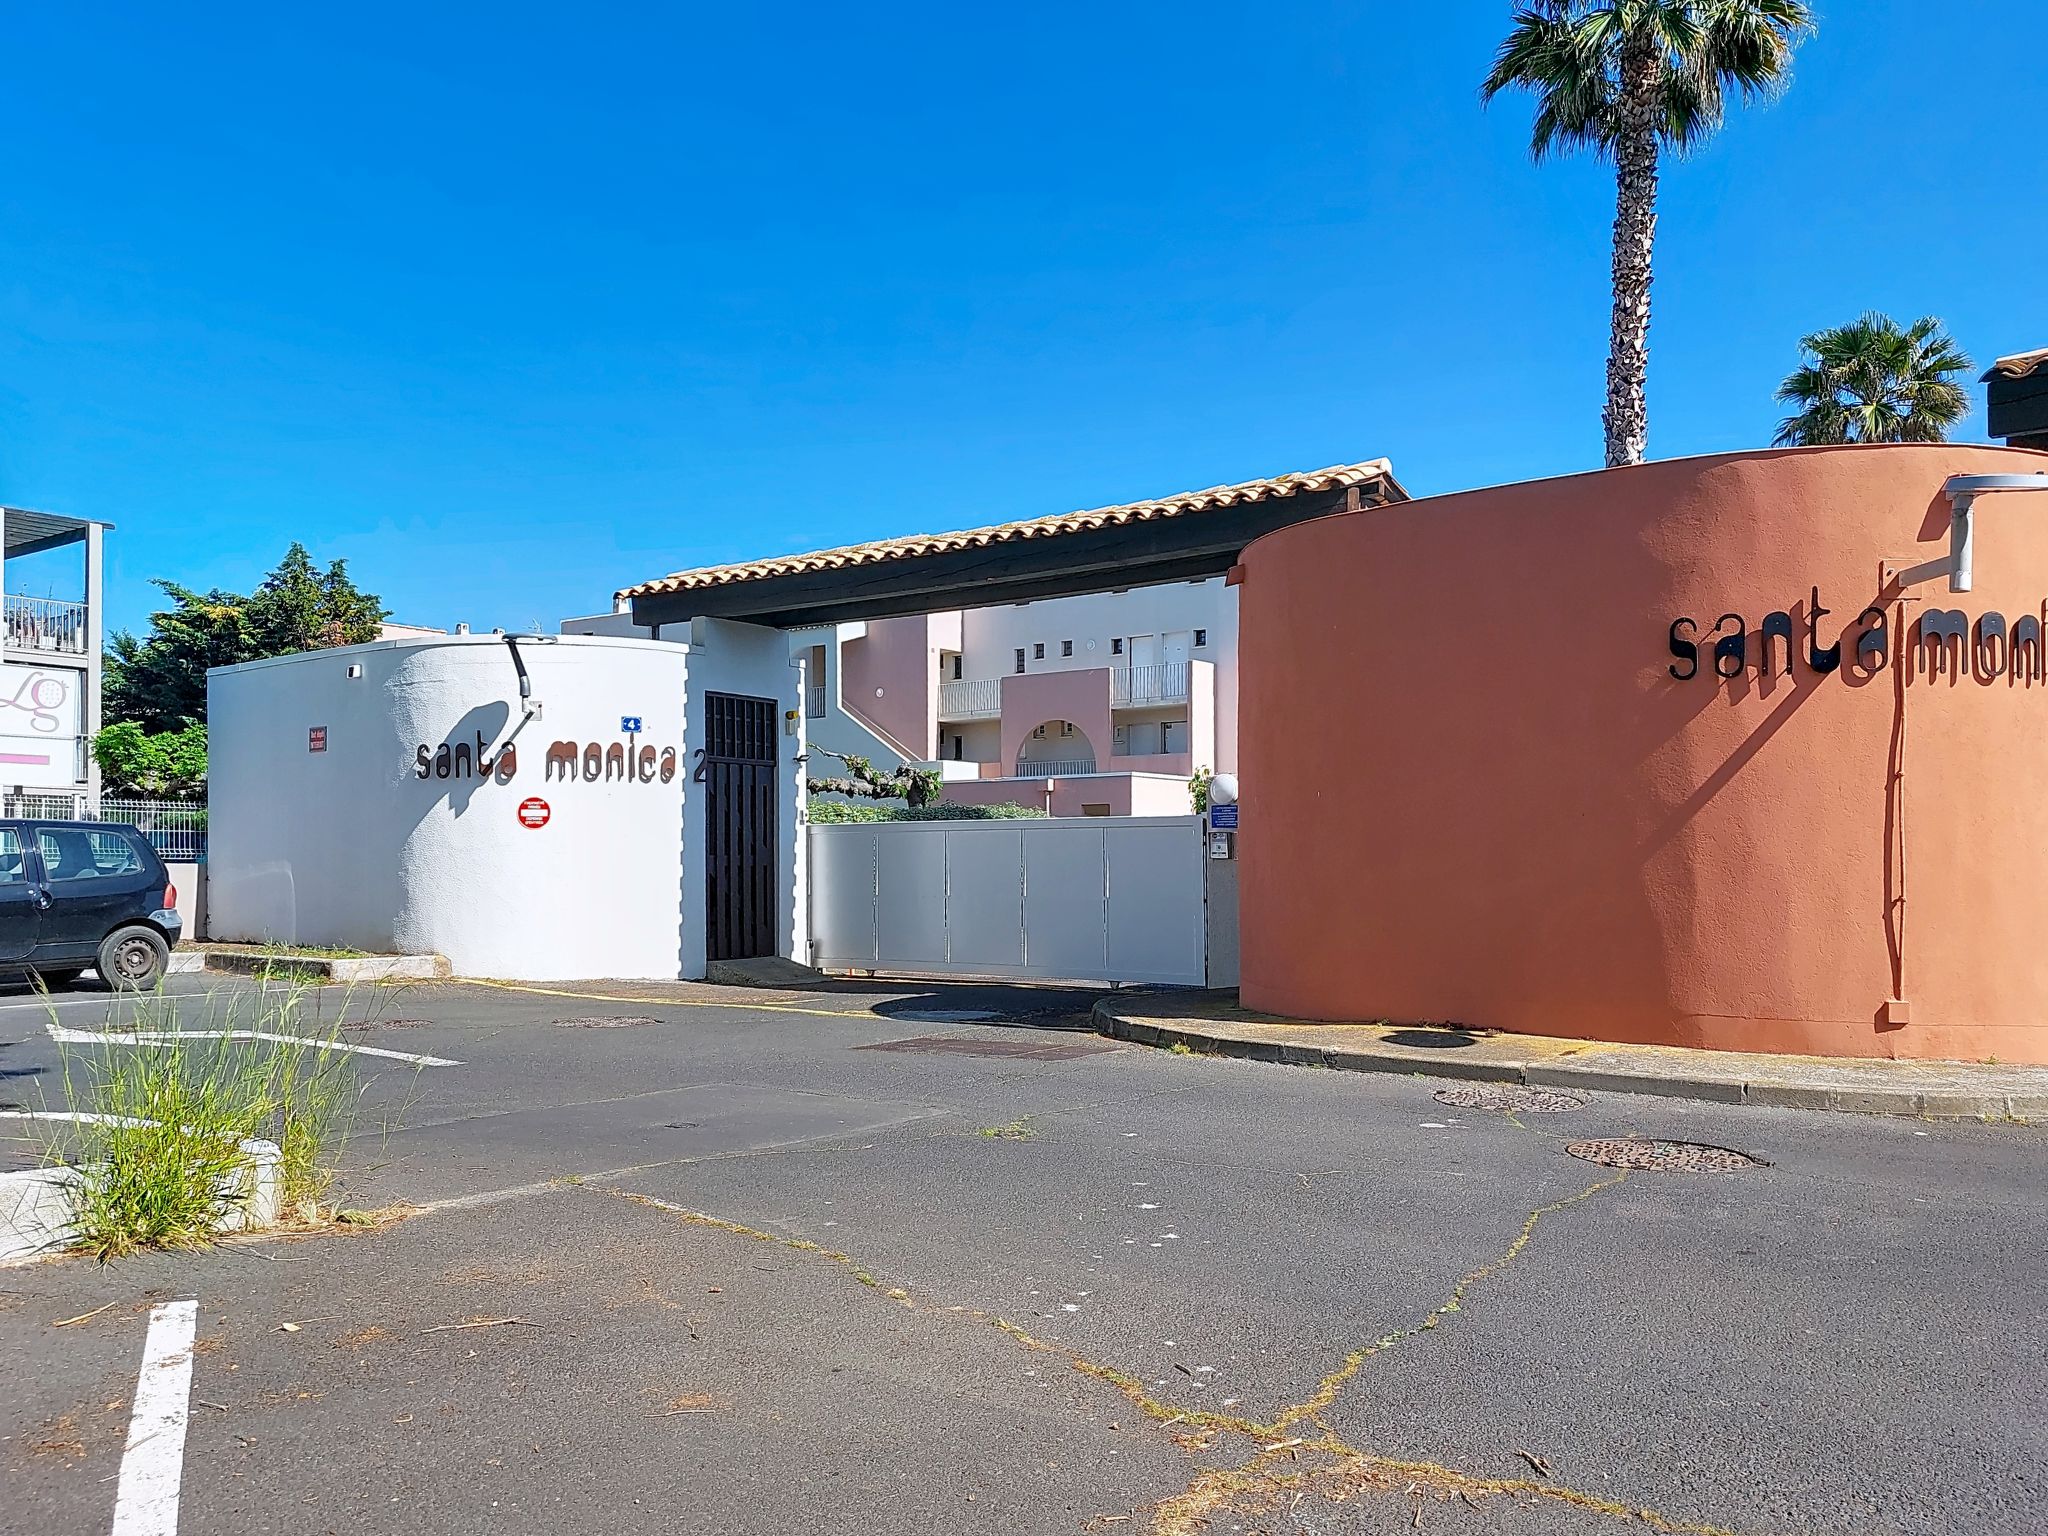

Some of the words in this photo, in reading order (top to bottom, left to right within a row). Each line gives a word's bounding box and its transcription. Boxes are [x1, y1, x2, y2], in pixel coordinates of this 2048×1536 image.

[1669, 586, 1888, 681] santa
[1919, 602, 2048, 681] mon
[627, 719, 636, 730] 4
[416, 730, 517, 782] santa
[546, 733, 676, 784] monica
[694, 748, 708, 783] 2
